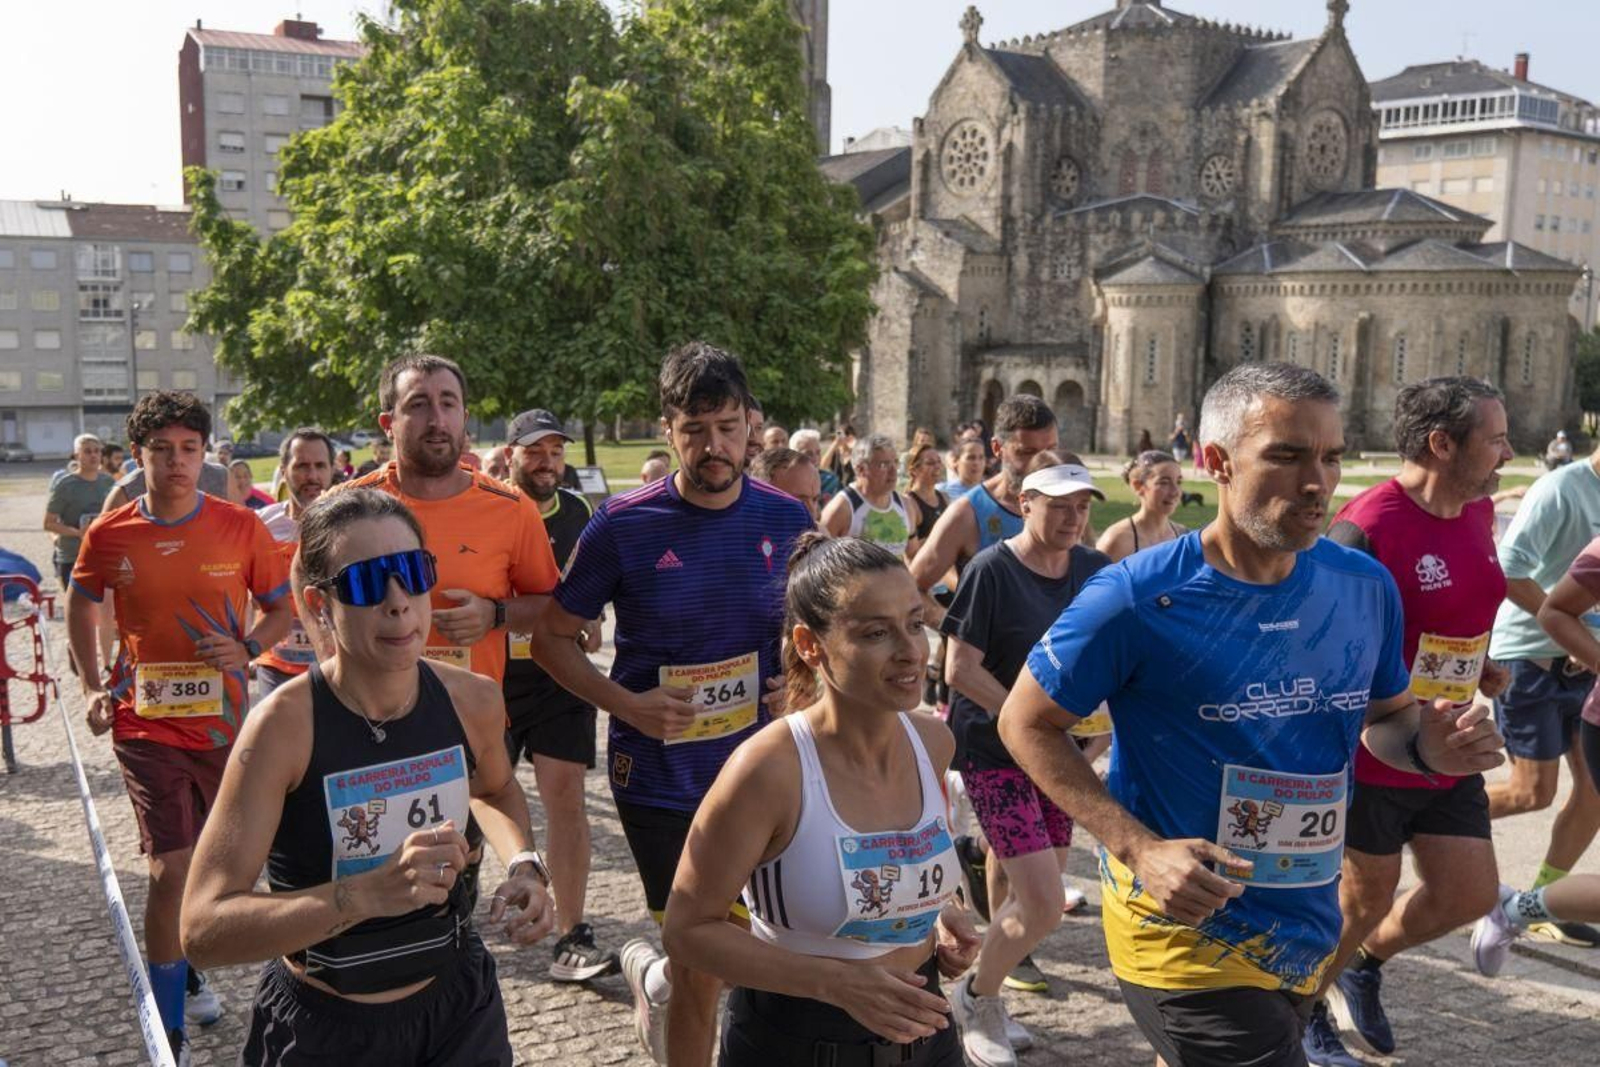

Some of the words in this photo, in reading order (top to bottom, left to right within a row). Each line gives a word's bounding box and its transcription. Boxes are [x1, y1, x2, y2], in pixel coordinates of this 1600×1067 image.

[426, 649, 463, 658] POPULA
[674, 665, 716, 678] CARREIRA
[717, 656, 751, 670] POPULAR
[691, 675, 705, 683] DO
[706, 670, 732, 681] PULPO
[171, 680, 211, 697] 380
[703, 680, 747, 706] 364
[1246, 677, 1316, 701] CLUB
[349, 764, 407, 787] CARREIRA
[408, 752, 456, 773] POPULAR
[374, 781, 392, 793] DO
[394, 771, 431, 789] PULPO
[1248, 774, 1313, 790] CARREIRA
[1274, 788, 1294, 799] DO
[1297, 789, 1334, 799] PULPO
[407, 793, 445, 829] 61
[1299, 809, 1337, 838] 20
[888, 848, 906, 860] DO
[917, 863, 944, 899] 19
